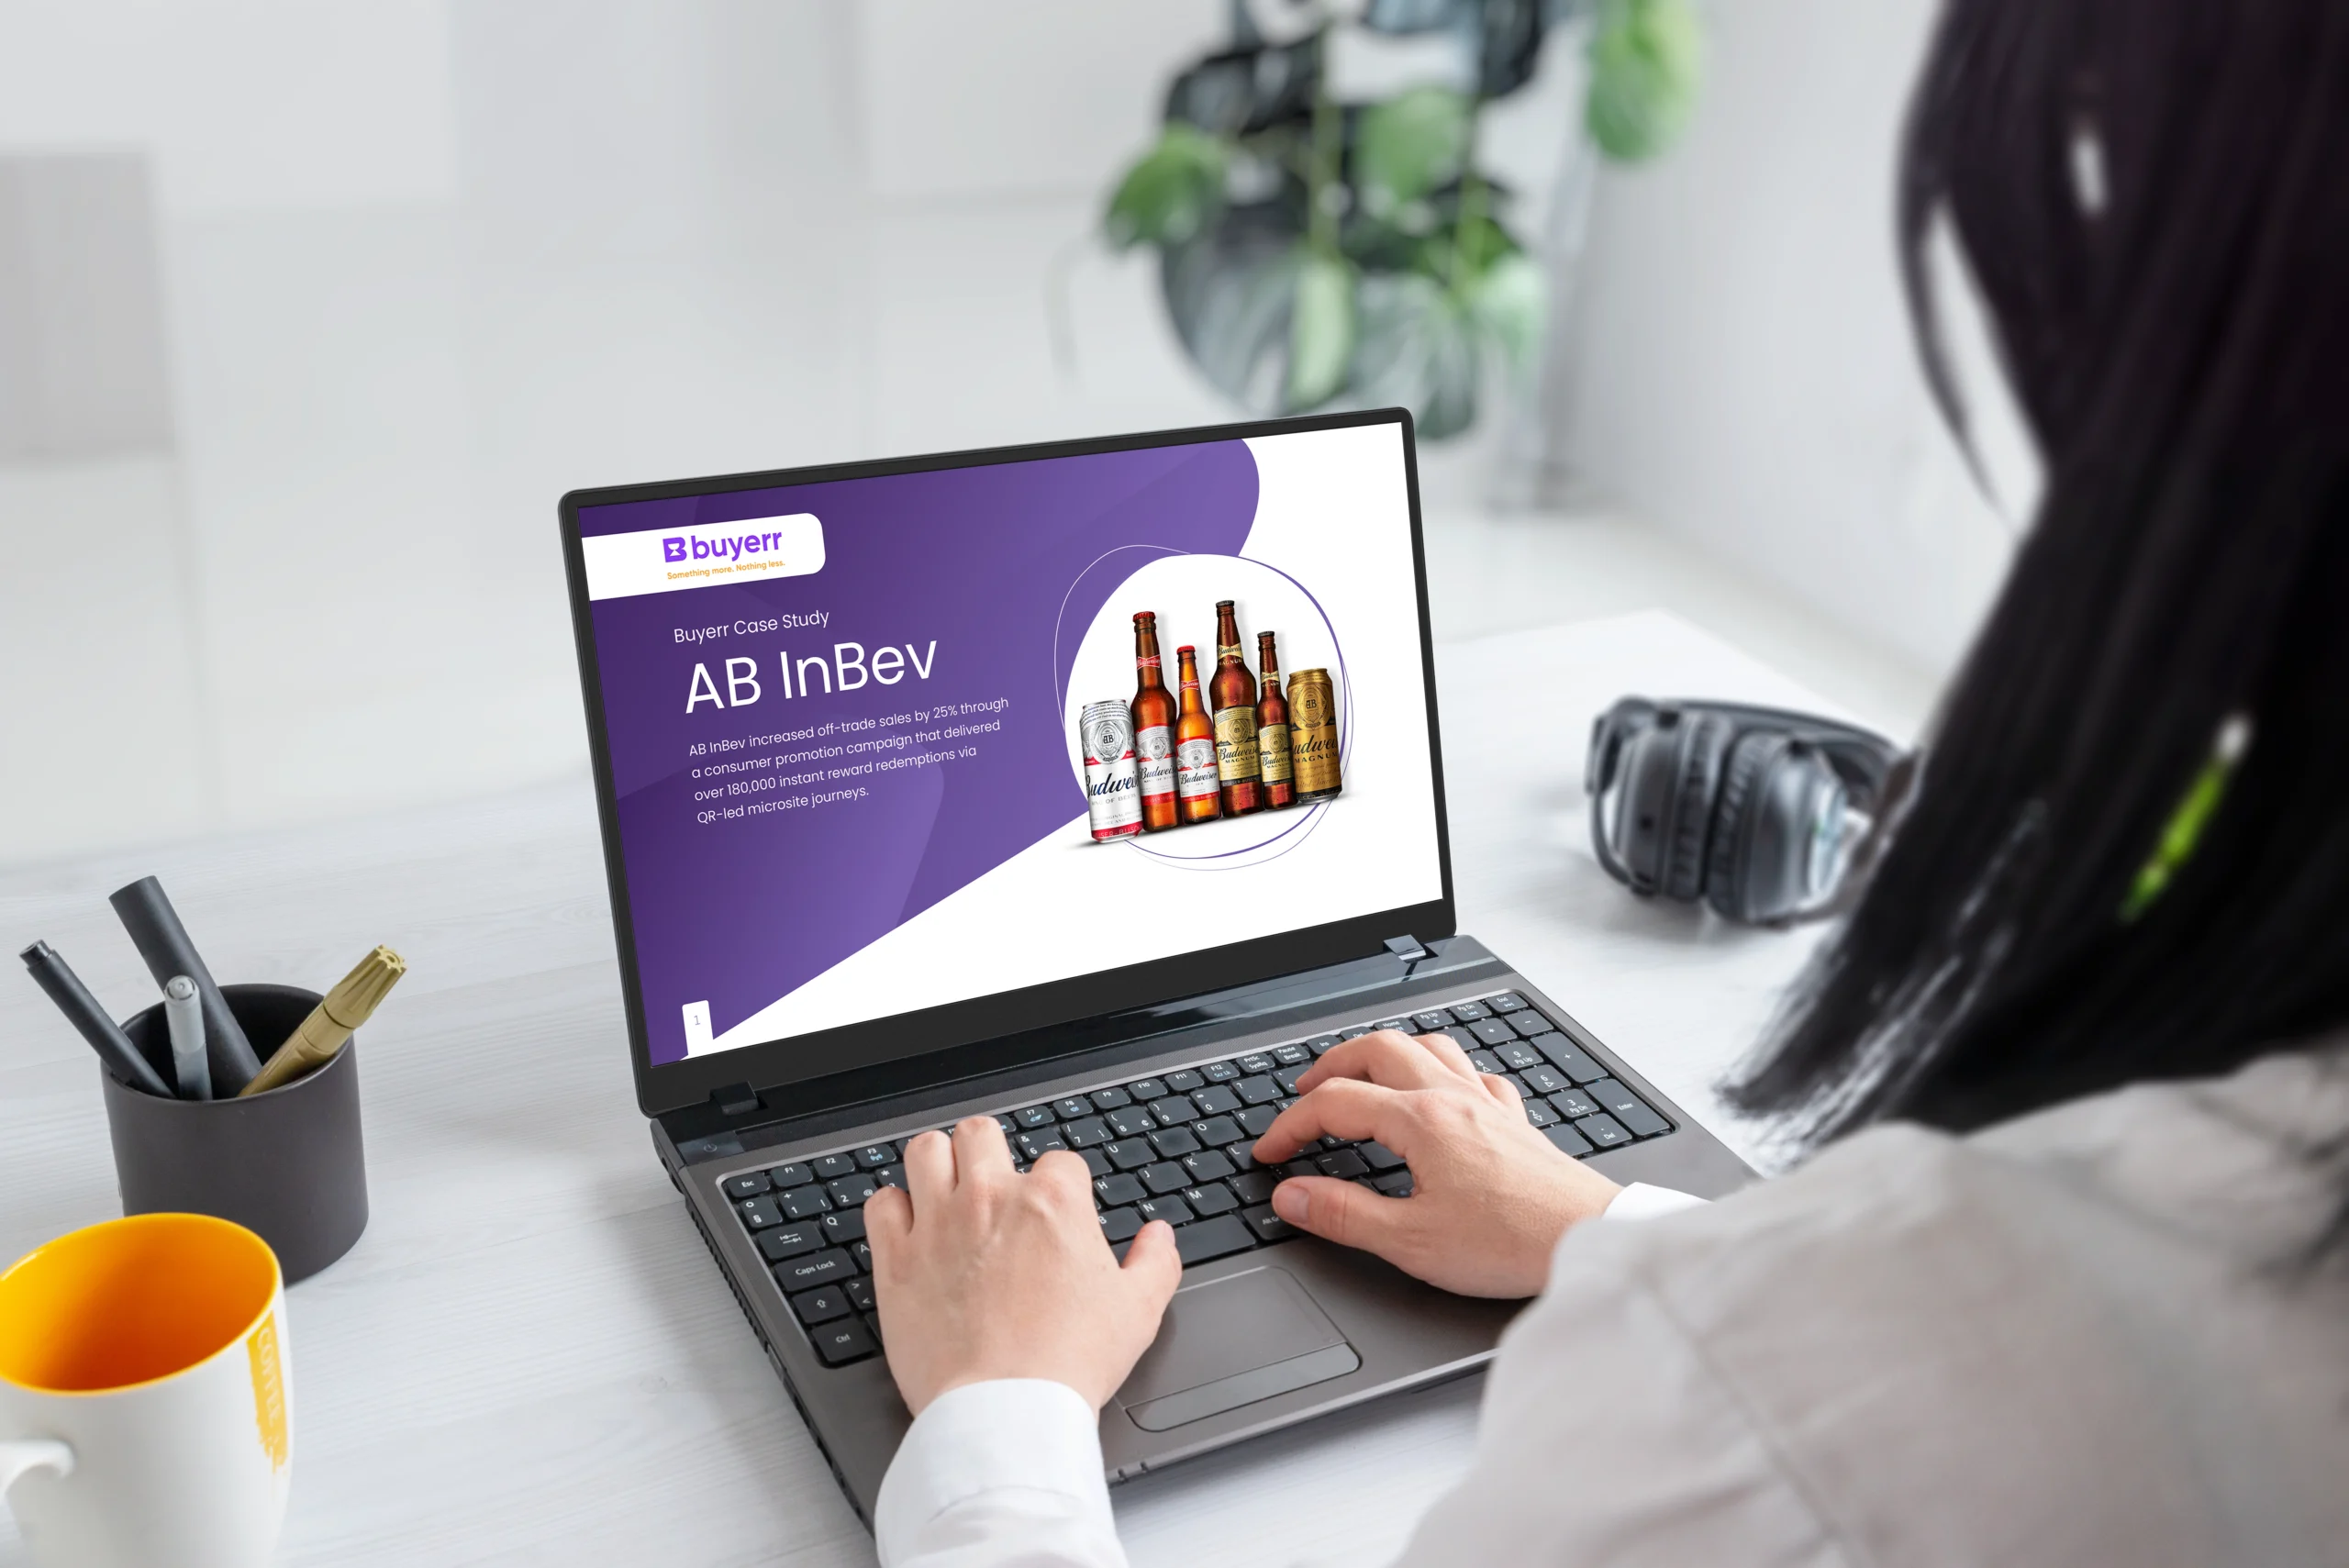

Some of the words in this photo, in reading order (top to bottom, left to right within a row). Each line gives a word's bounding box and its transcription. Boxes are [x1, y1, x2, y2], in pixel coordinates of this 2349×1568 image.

[691, 532, 782, 562] buyerr
[667, 568, 710, 580] Something
[712, 565, 734, 575] more.
[736, 562, 767, 573] Nothing
[768, 560, 785, 569] less.
[674, 623, 729, 644] Buyerr
[734, 617, 778, 635] Case
[782, 610, 829, 628] Study
[685, 656, 762, 714] AB
[780, 640, 937, 699] InBev
[689, 743, 707, 756] AB
[710, 739, 745, 753] InBev
[749, 726, 815, 747] increased
[818, 718, 876, 737] off-trade
[879, 714, 911, 727] sales
[915, 710, 930, 723] by
[933, 705, 958, 718] 25%
[960, 697, 1008, 715] through
[692, 768, 701, 779] a
[705, 757, 772, 777] consumer
[775, 745, 843, 769] promotion
[846, 735, 913, 753] campaign
[915, 728, 941, 743] that
[943, 719, 1000, 739] delivered
[1225, 754, 1255, 763] MAGNUM
[695, 787, 724, 801] over
[727, 777, 775, 795] 180,000
[779, 770, 825, 787] instant
[828, 762, 872, 779] reward
[875, 750, 955, 772] redemptions
[958, 745, 977, 758] via
[696, 805, 744, 825] QR-led
[748, 795, 808, 816] microsite
[811, 786, 869, 808] journeys.
[1277, 1046, 1296, 1054] Pause
[1284, 1051, 1302, 1061] Break
[1618, 1103, 1633, 1111] Enter
[1143, 1170, 1151, 1178] J
[741, 1180, 754, 1188] Esc
[1189, 1190, 1202, 1199] M
[1142, 1203, 1154, 1212] N
[827, 1217, 838, 1226] Q
[860, 1244, 870, 1252] A
[796, 1266, 816, 1275] Caps
[816, 1261, 836, 1270] Lock
[836, 1333, 851, 1343] Ctrl
